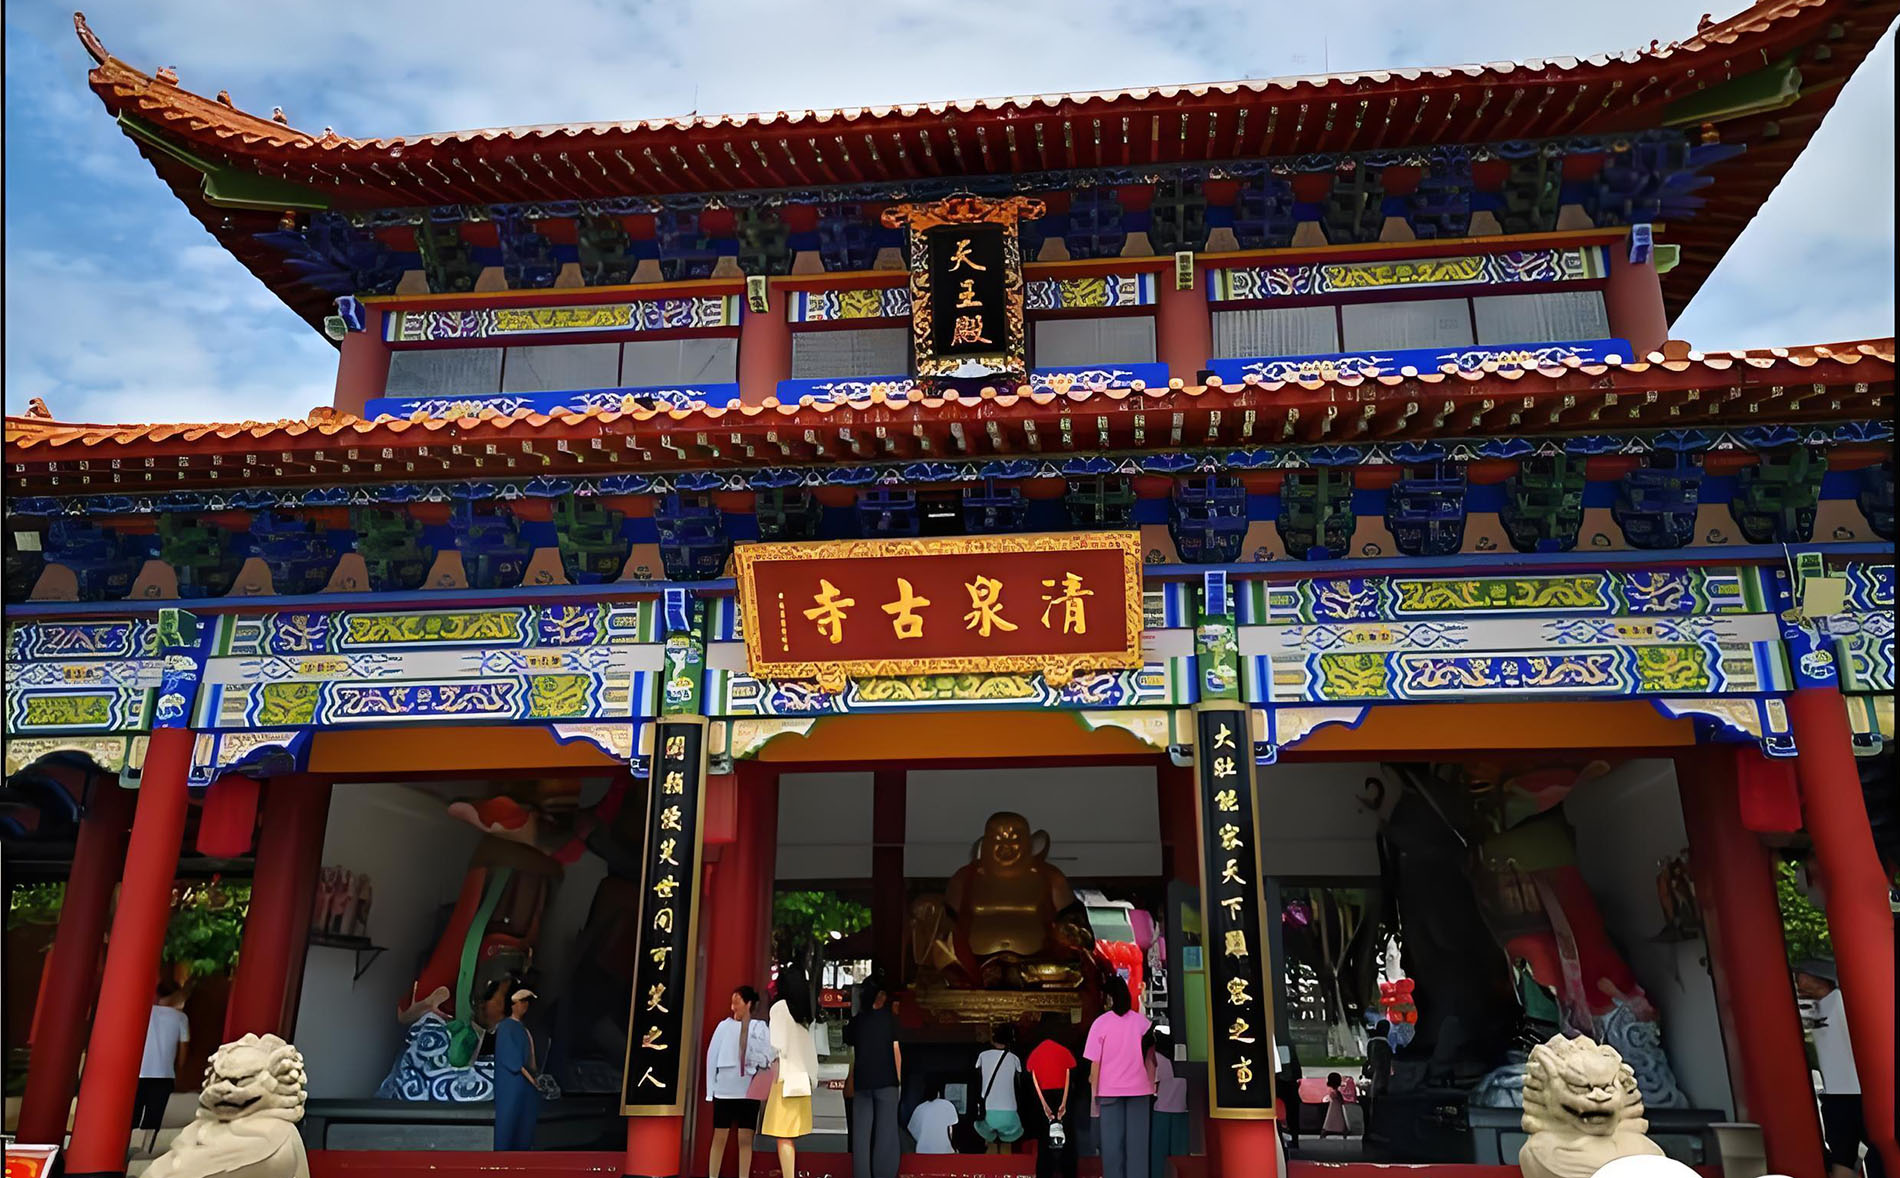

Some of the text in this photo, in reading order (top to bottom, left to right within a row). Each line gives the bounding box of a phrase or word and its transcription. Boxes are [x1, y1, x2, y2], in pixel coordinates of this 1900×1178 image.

[948, 239, 993, 347] 天王殿
[802, 571, 1095, 644] 清泉古寺
